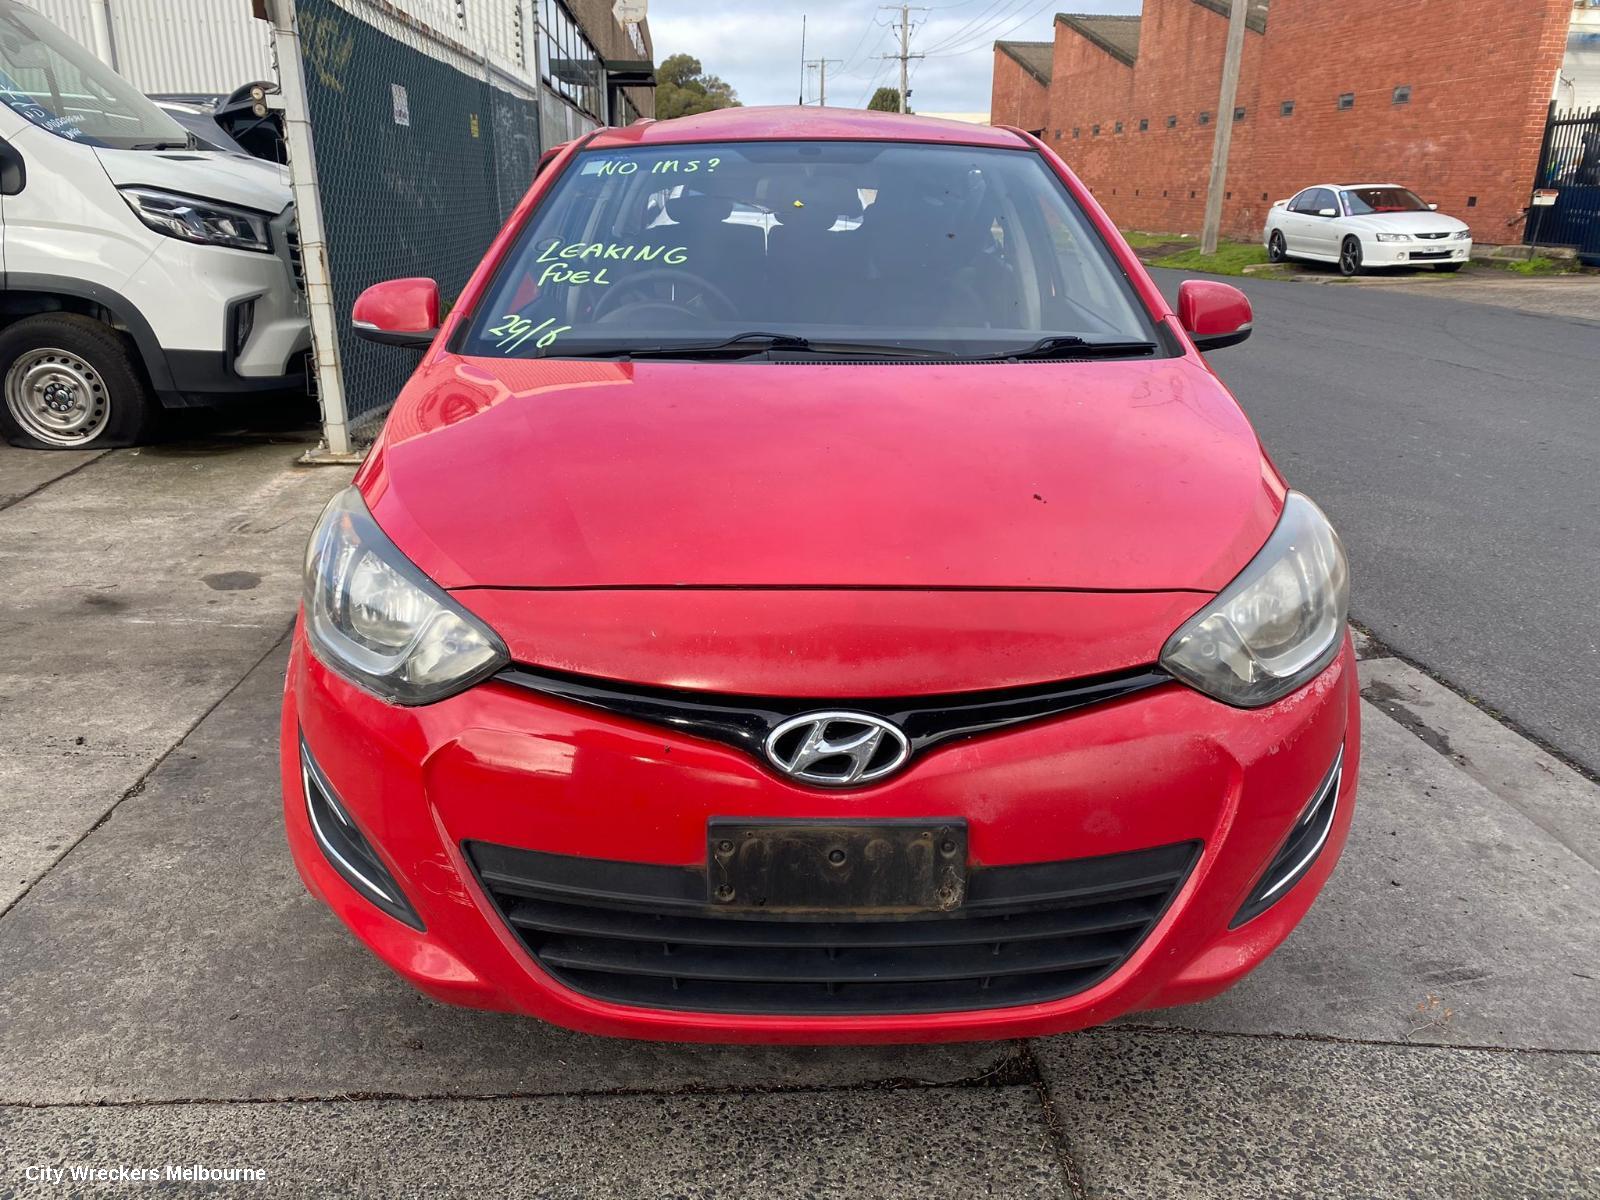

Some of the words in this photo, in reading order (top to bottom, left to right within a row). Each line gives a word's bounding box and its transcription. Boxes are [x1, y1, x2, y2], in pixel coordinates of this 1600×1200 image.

[597, 160, 638, 177] NO
[535, 240, 688, 264] LEAKING
[536, 262, 610, 287] FUEL
